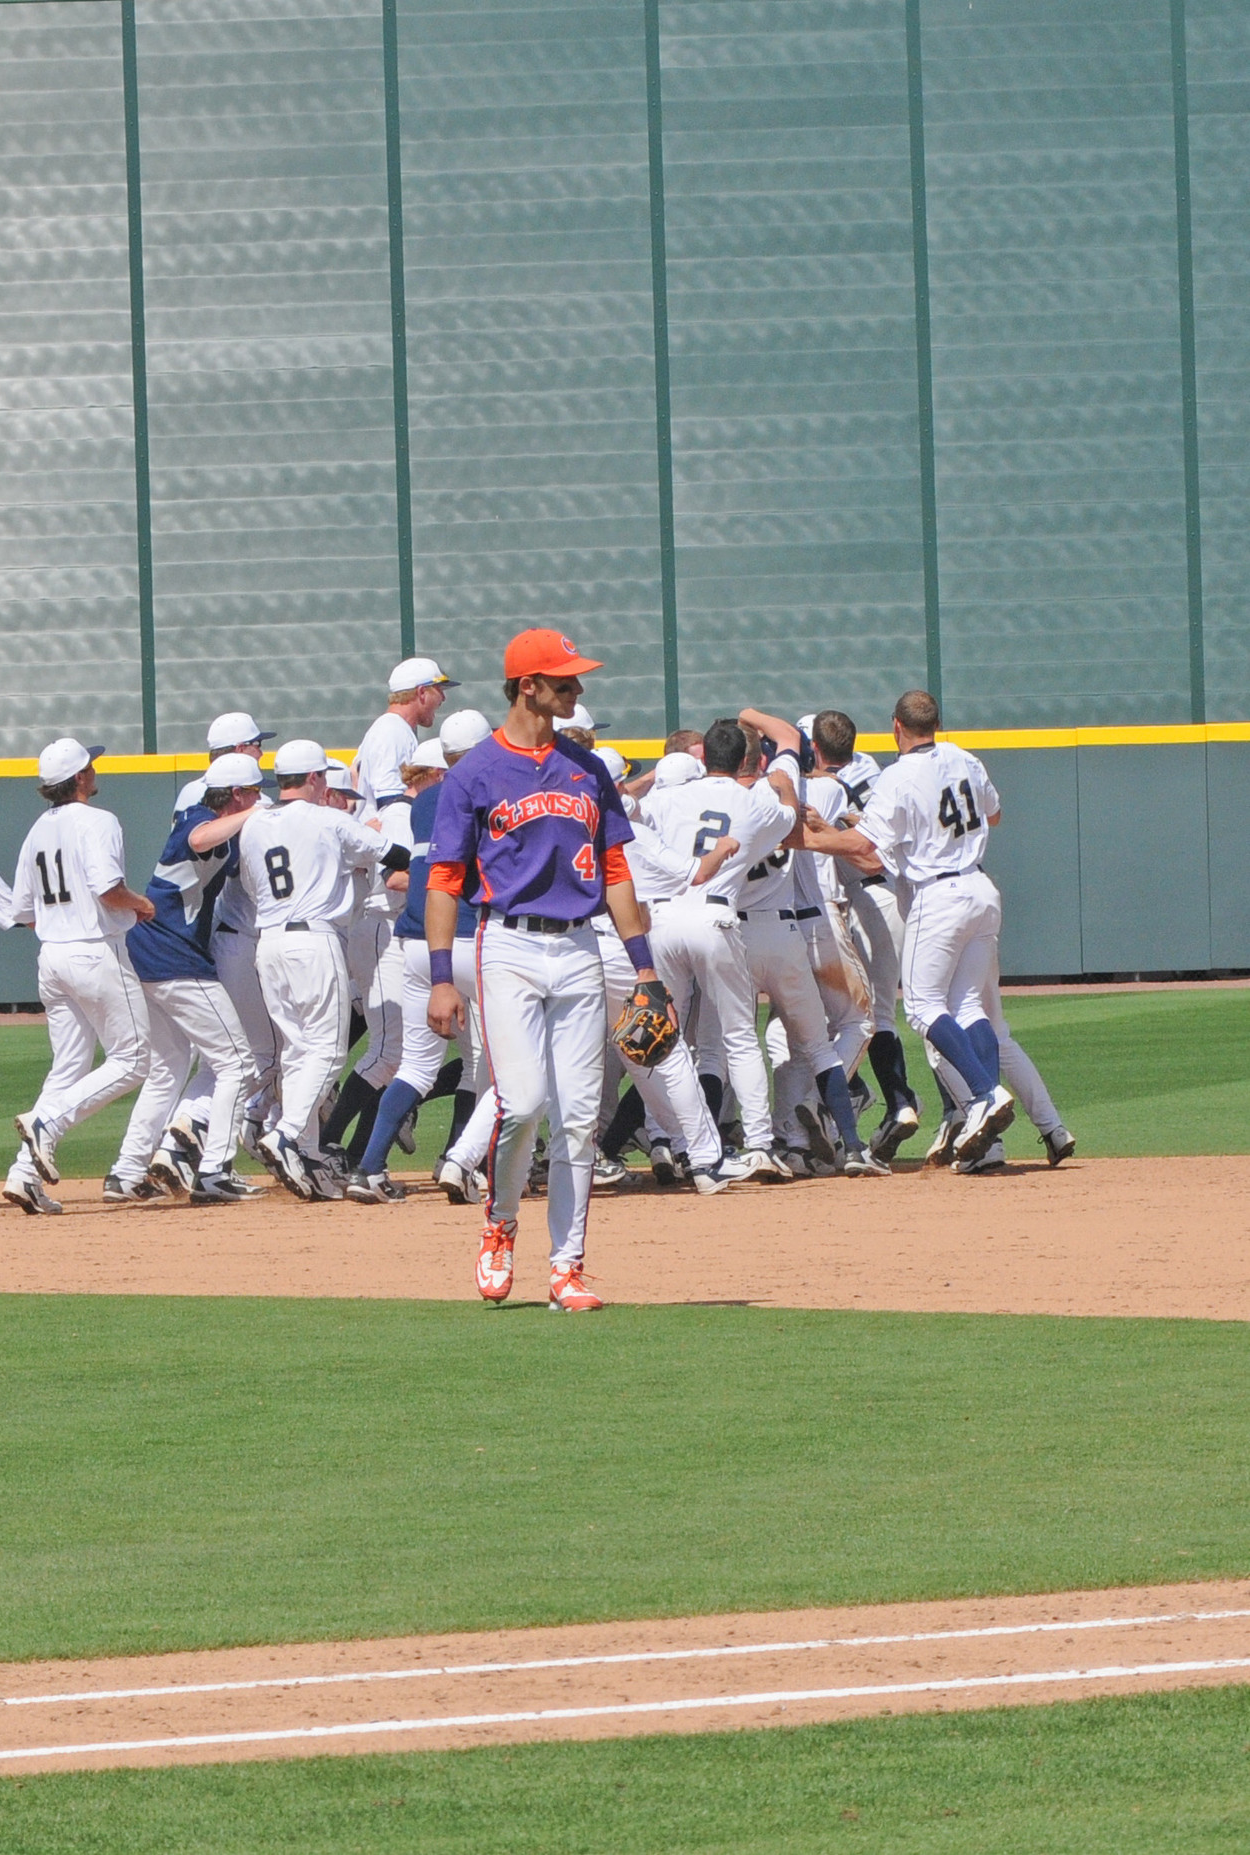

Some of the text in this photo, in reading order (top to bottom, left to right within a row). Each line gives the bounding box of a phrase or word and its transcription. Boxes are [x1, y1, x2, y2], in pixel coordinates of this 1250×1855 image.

[488, 791, 600, 842] CLEMSON
[693, 809, 732, 858] 2
[938, 778, 982, 838] 41
[36, 848, 71, 905] 11
[264, 845, 294, 900] 8
[571, 843, 596, 881] 4
